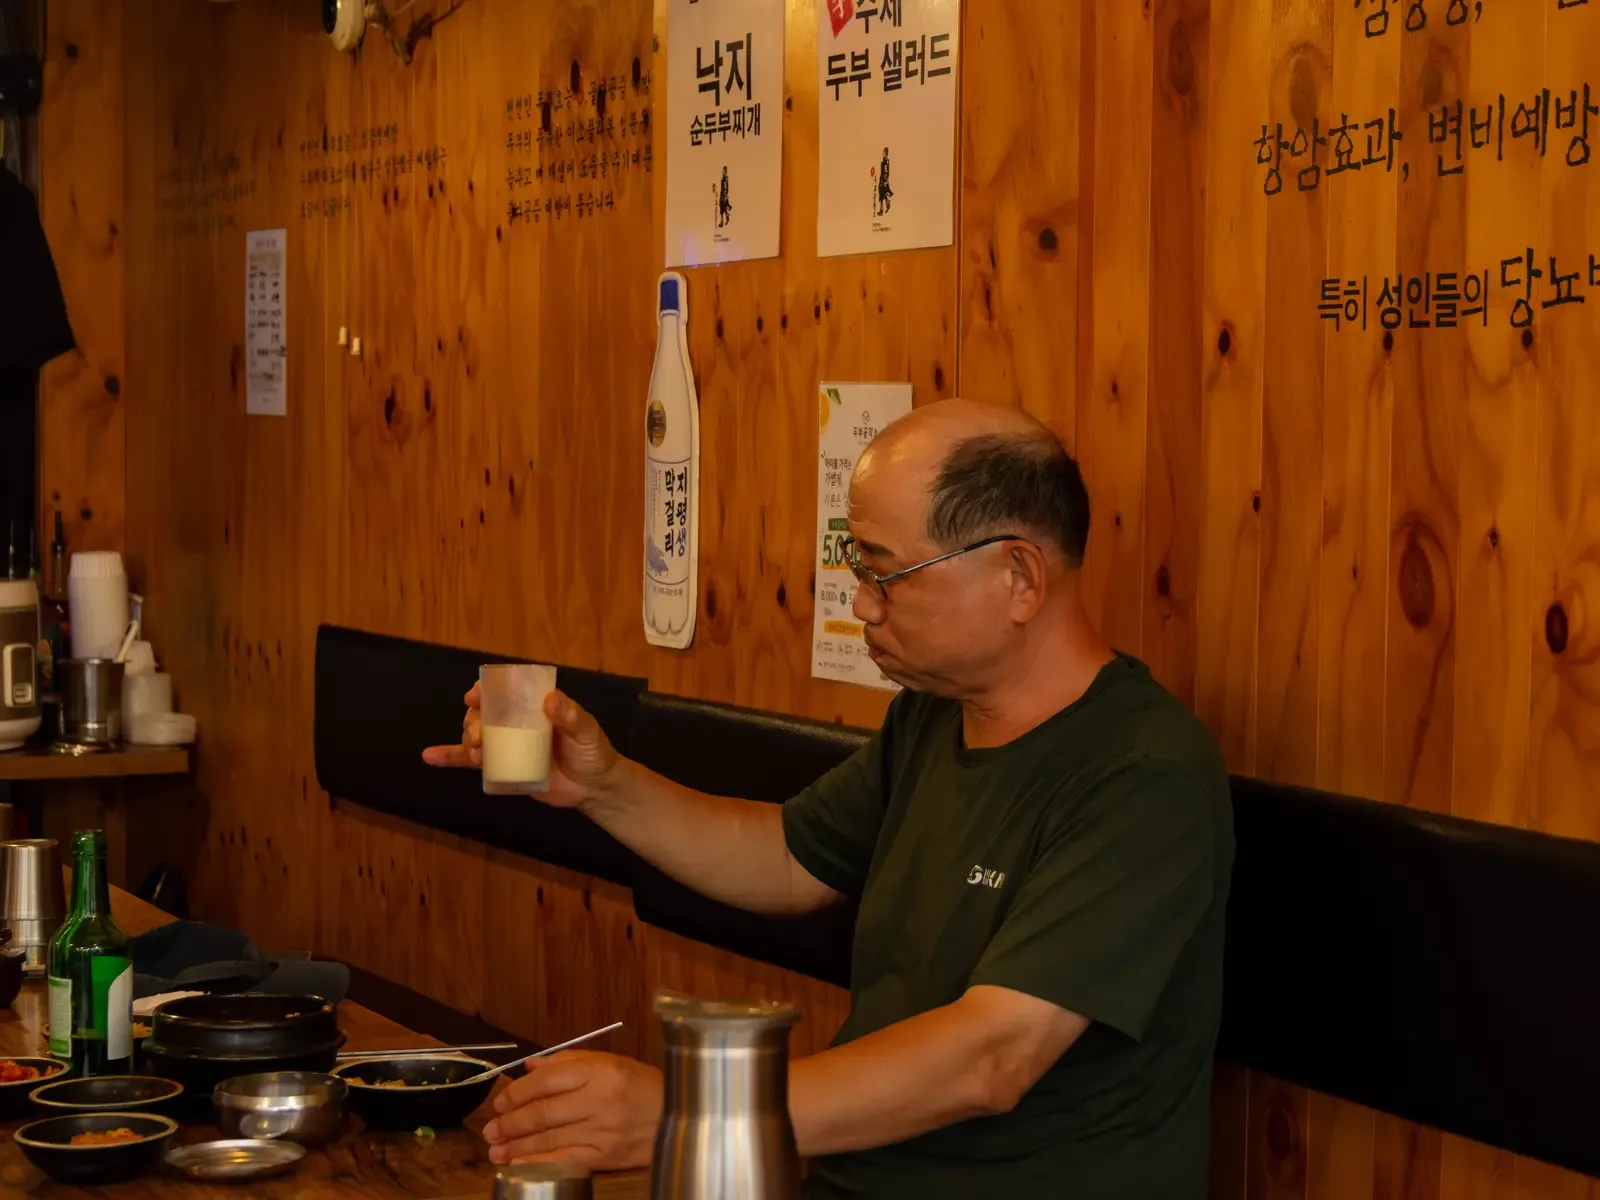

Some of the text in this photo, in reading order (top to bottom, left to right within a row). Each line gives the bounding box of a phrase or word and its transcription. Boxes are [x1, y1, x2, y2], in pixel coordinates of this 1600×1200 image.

[696, 32, 753, 107] 낙지
[826, 33, 952, 102] 두부 샐러드
[690, 103, 761, 147] 순두부찌개
[1253, 83, 1600, 196] 항암효과, 변비예방
[1317, 275, 1368, 332] 특히
[1376, 269, 1488, 330] 성인들의
[664, 467, 676, 559] 막걸리
[675, 466, 688, 557] 지평생
